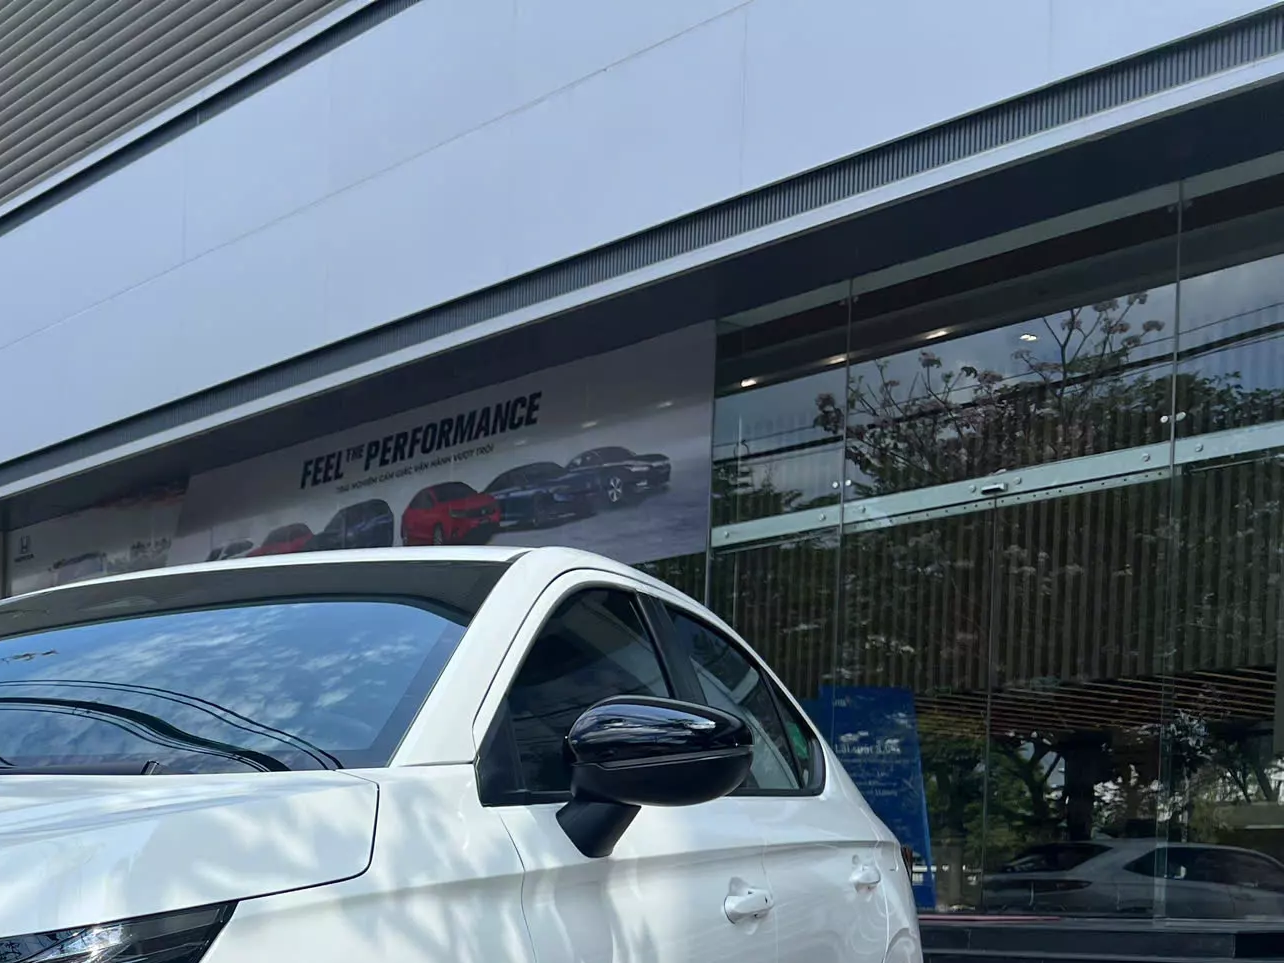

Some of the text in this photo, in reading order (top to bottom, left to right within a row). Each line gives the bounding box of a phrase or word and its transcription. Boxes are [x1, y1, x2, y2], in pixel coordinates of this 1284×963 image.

[300, 391, 542, 489] FEEL THE PERFORMANCE
